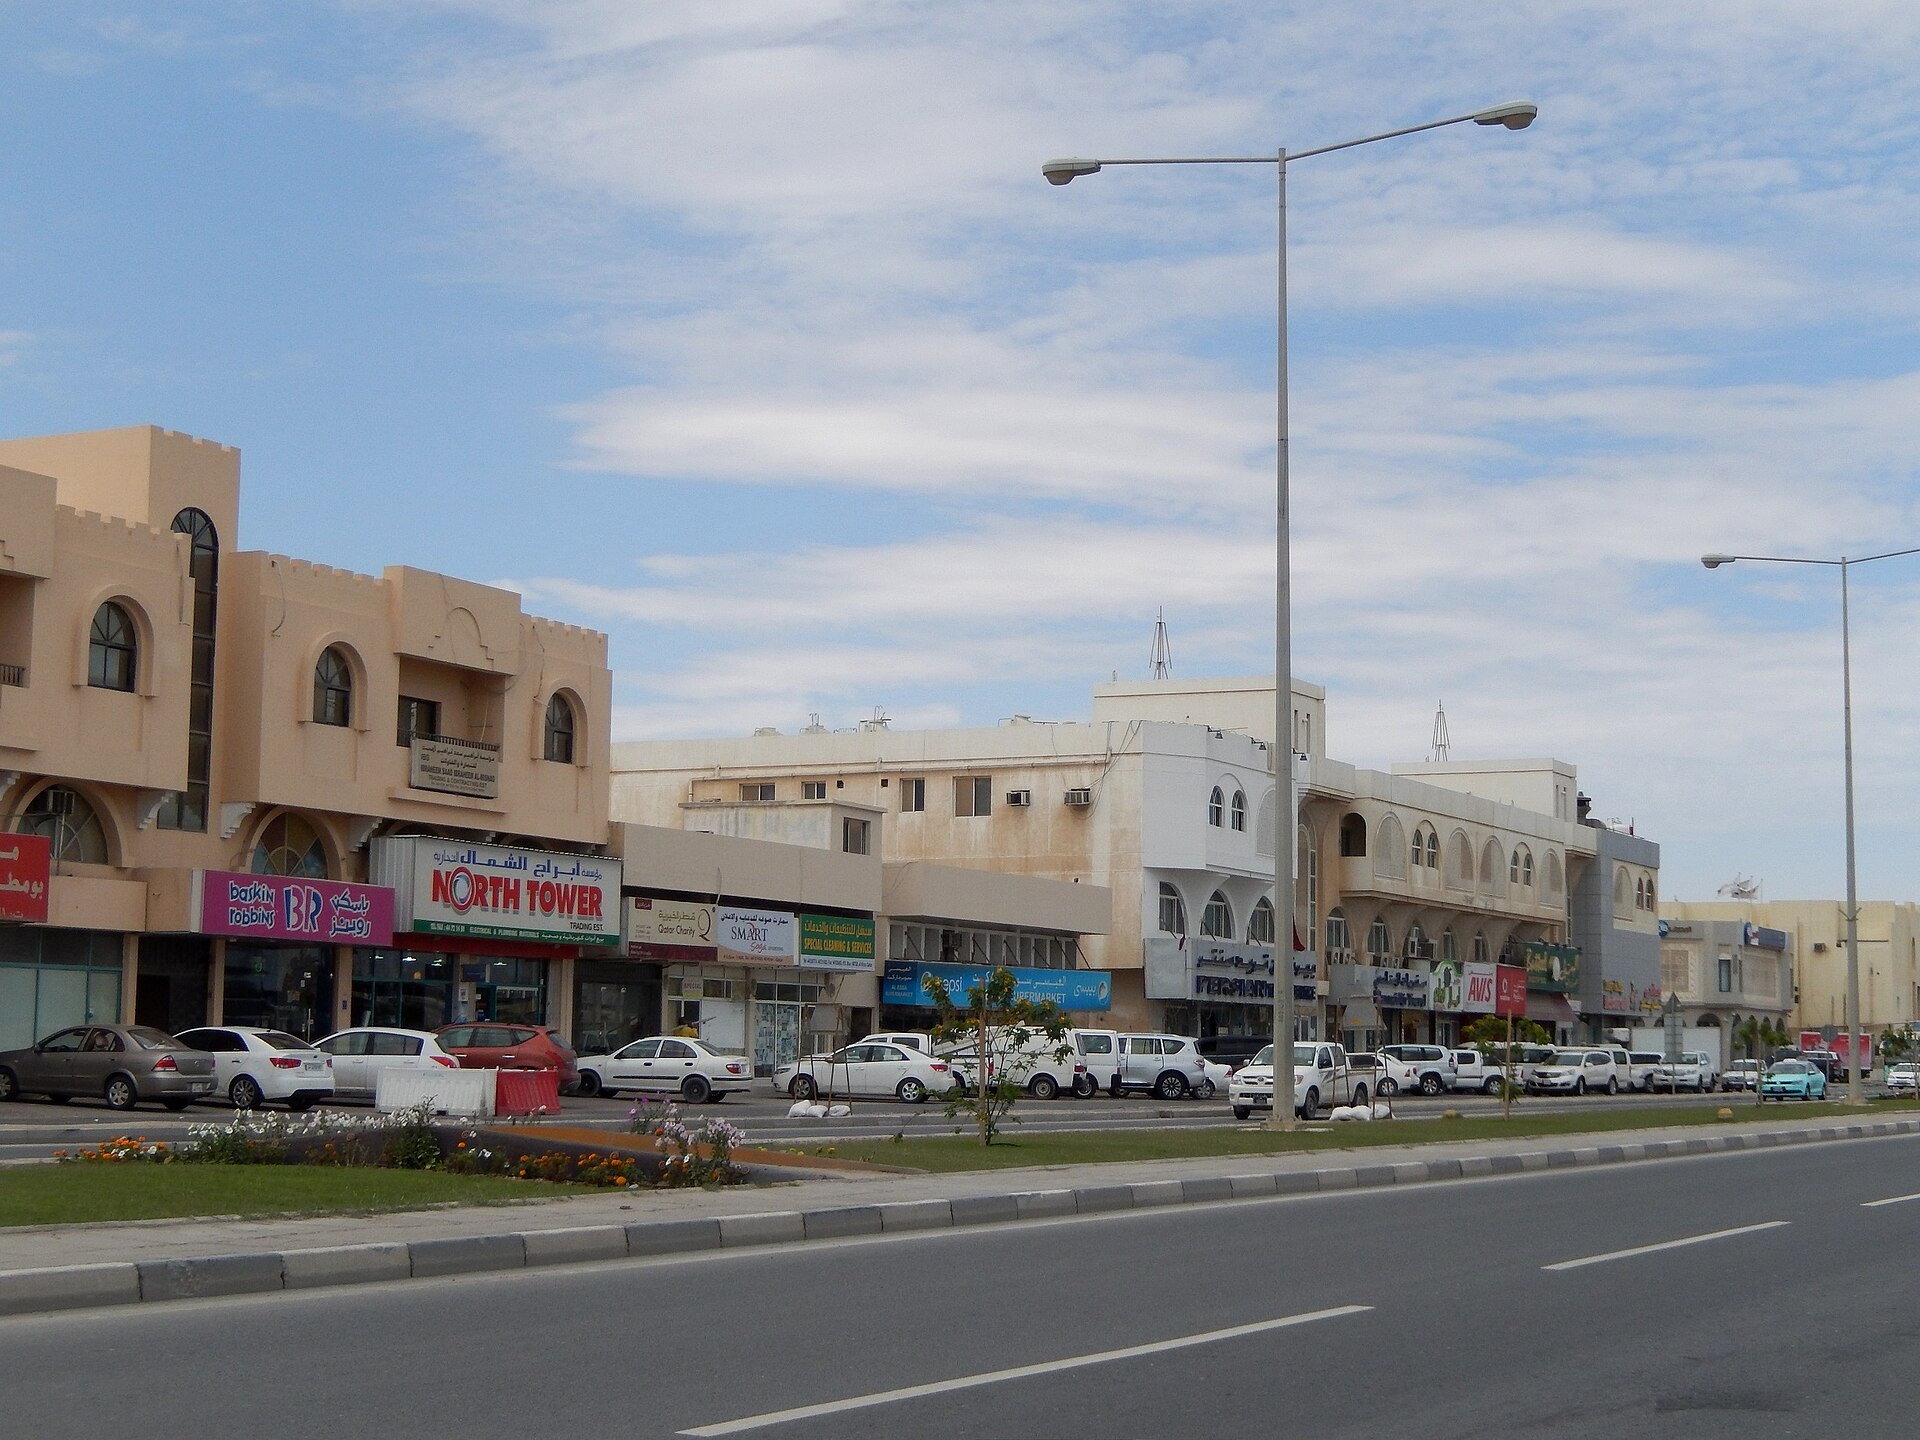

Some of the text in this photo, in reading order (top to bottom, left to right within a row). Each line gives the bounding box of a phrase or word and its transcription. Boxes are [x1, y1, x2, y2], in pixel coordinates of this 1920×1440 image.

[229, 880, 275, 908] baskin
[432, 866, 603, 917] NORTH TOWER
[229, 906, 275, 929] robbins
[284, 885, 323, 932] BR
[570, 921, 593, 931] TRADING
[658, 924, 675, 934] Qatar
[676, 925, 696, 938] Charity
[731, 923, 768, 942] SMART
[804, 937, 823, 951] SPECIAL
[1467, 976, 1493, 1003] AVIS
